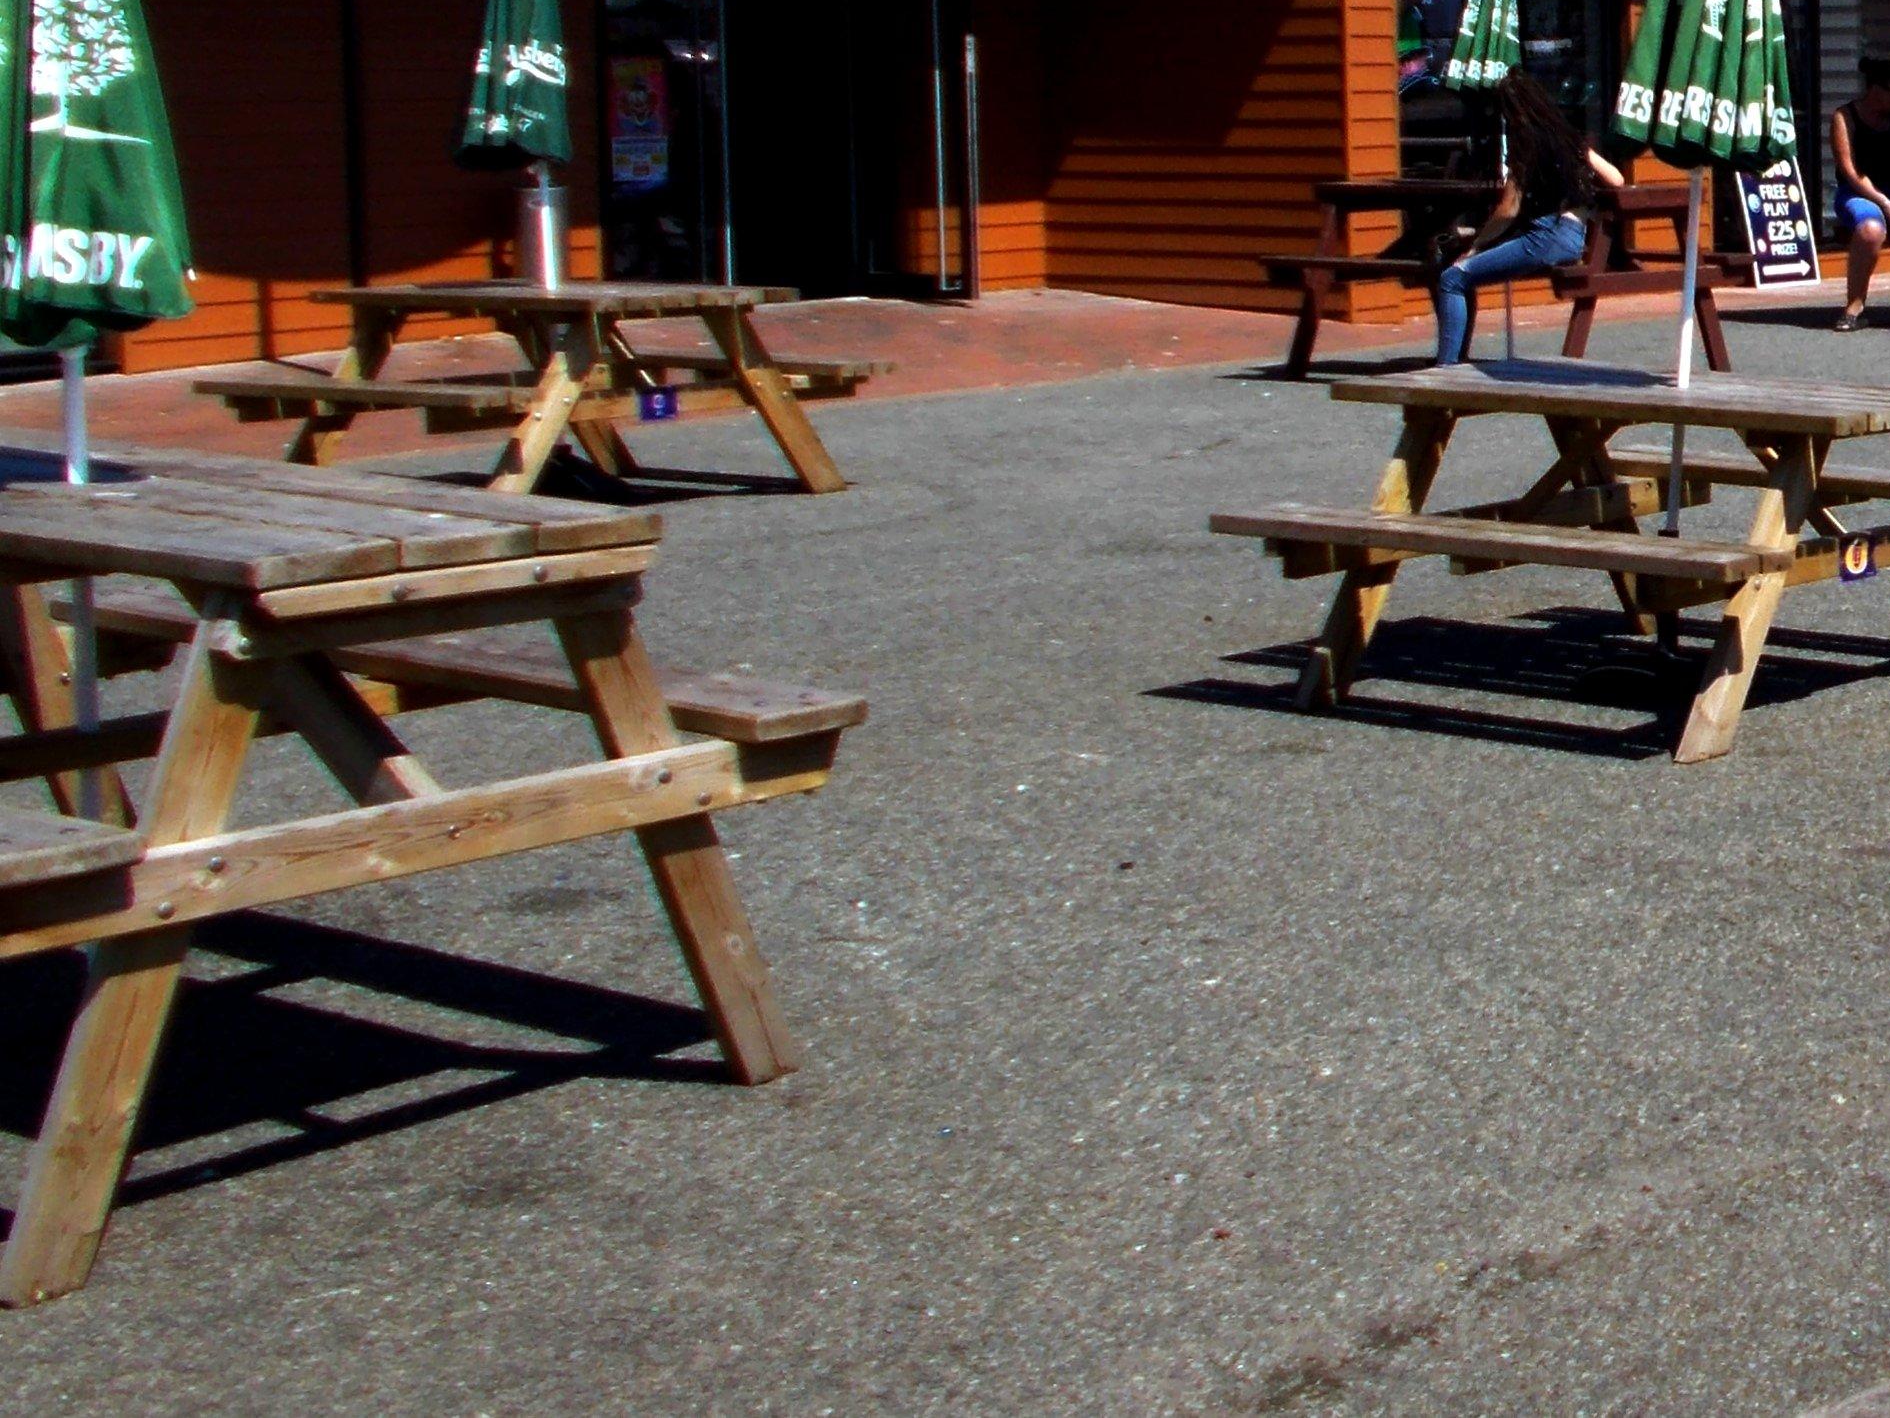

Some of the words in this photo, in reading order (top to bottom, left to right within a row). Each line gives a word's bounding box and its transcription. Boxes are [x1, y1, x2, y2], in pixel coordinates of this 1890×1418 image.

[1759, 184, 1788, 200] FREE
[1763, 202, 1789, 217] PLAY
[1768, 220, 1795, 241] £25
